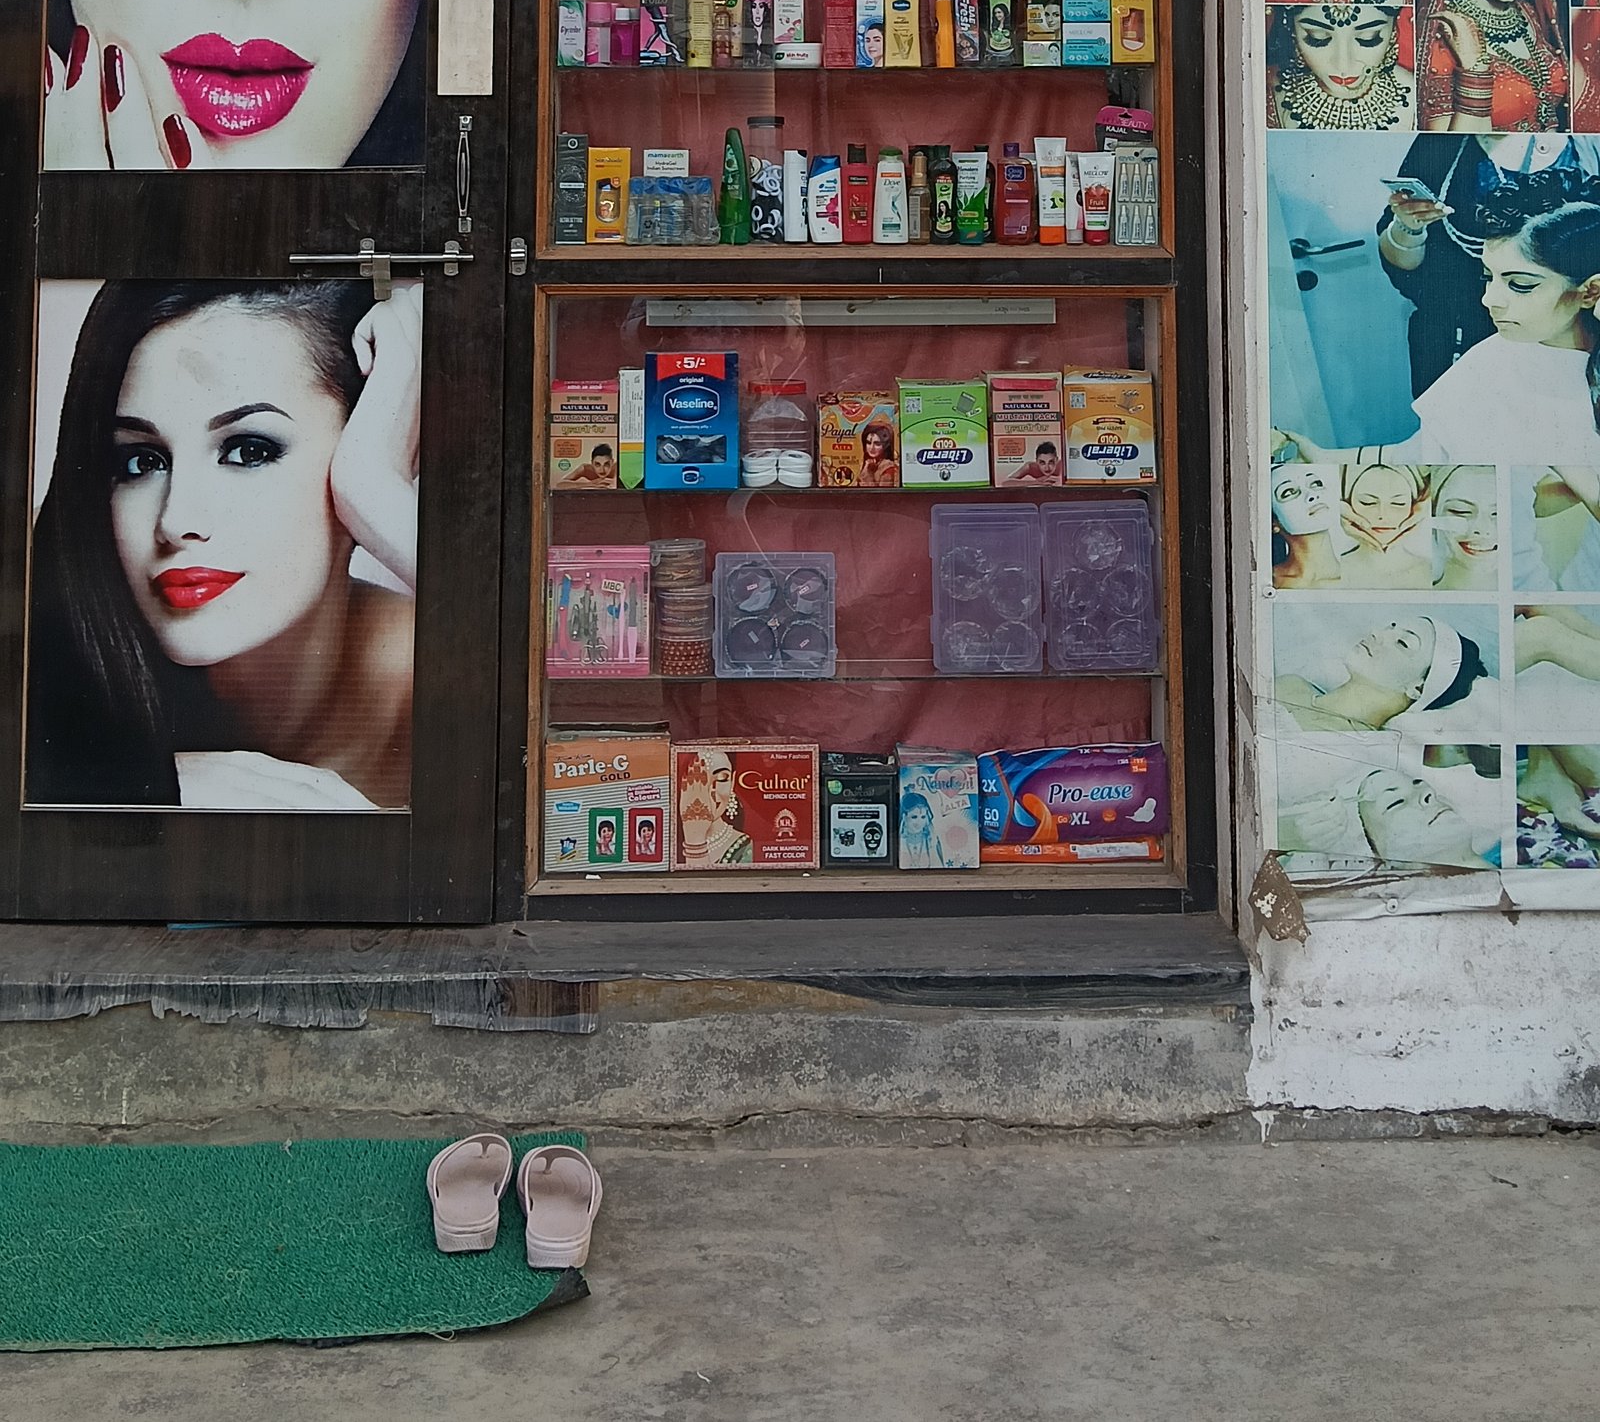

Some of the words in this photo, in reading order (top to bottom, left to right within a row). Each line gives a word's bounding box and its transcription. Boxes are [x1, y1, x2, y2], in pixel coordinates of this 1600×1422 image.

[883, 178, 901, 186] Dove
[679, 376, 704, 384] original
[669, 398, 715, 409] Vaseline
[820, 423, 857, 443] Payal
[921, 450, 968, 463] Liberal
[1086, 445, 1134, 458] Liberal
[603, 581, 621, 591] MBC
[553, 755, 629, 779] Parle-G
[600, 772, 631, 782] GOLD
[738, 770, 811, 792] Gulnar
[981, 779, 998, 793] 2X
[1048, 782, 1133, 805] Pro-ease
[946, 799, 969, 812] ALTA
